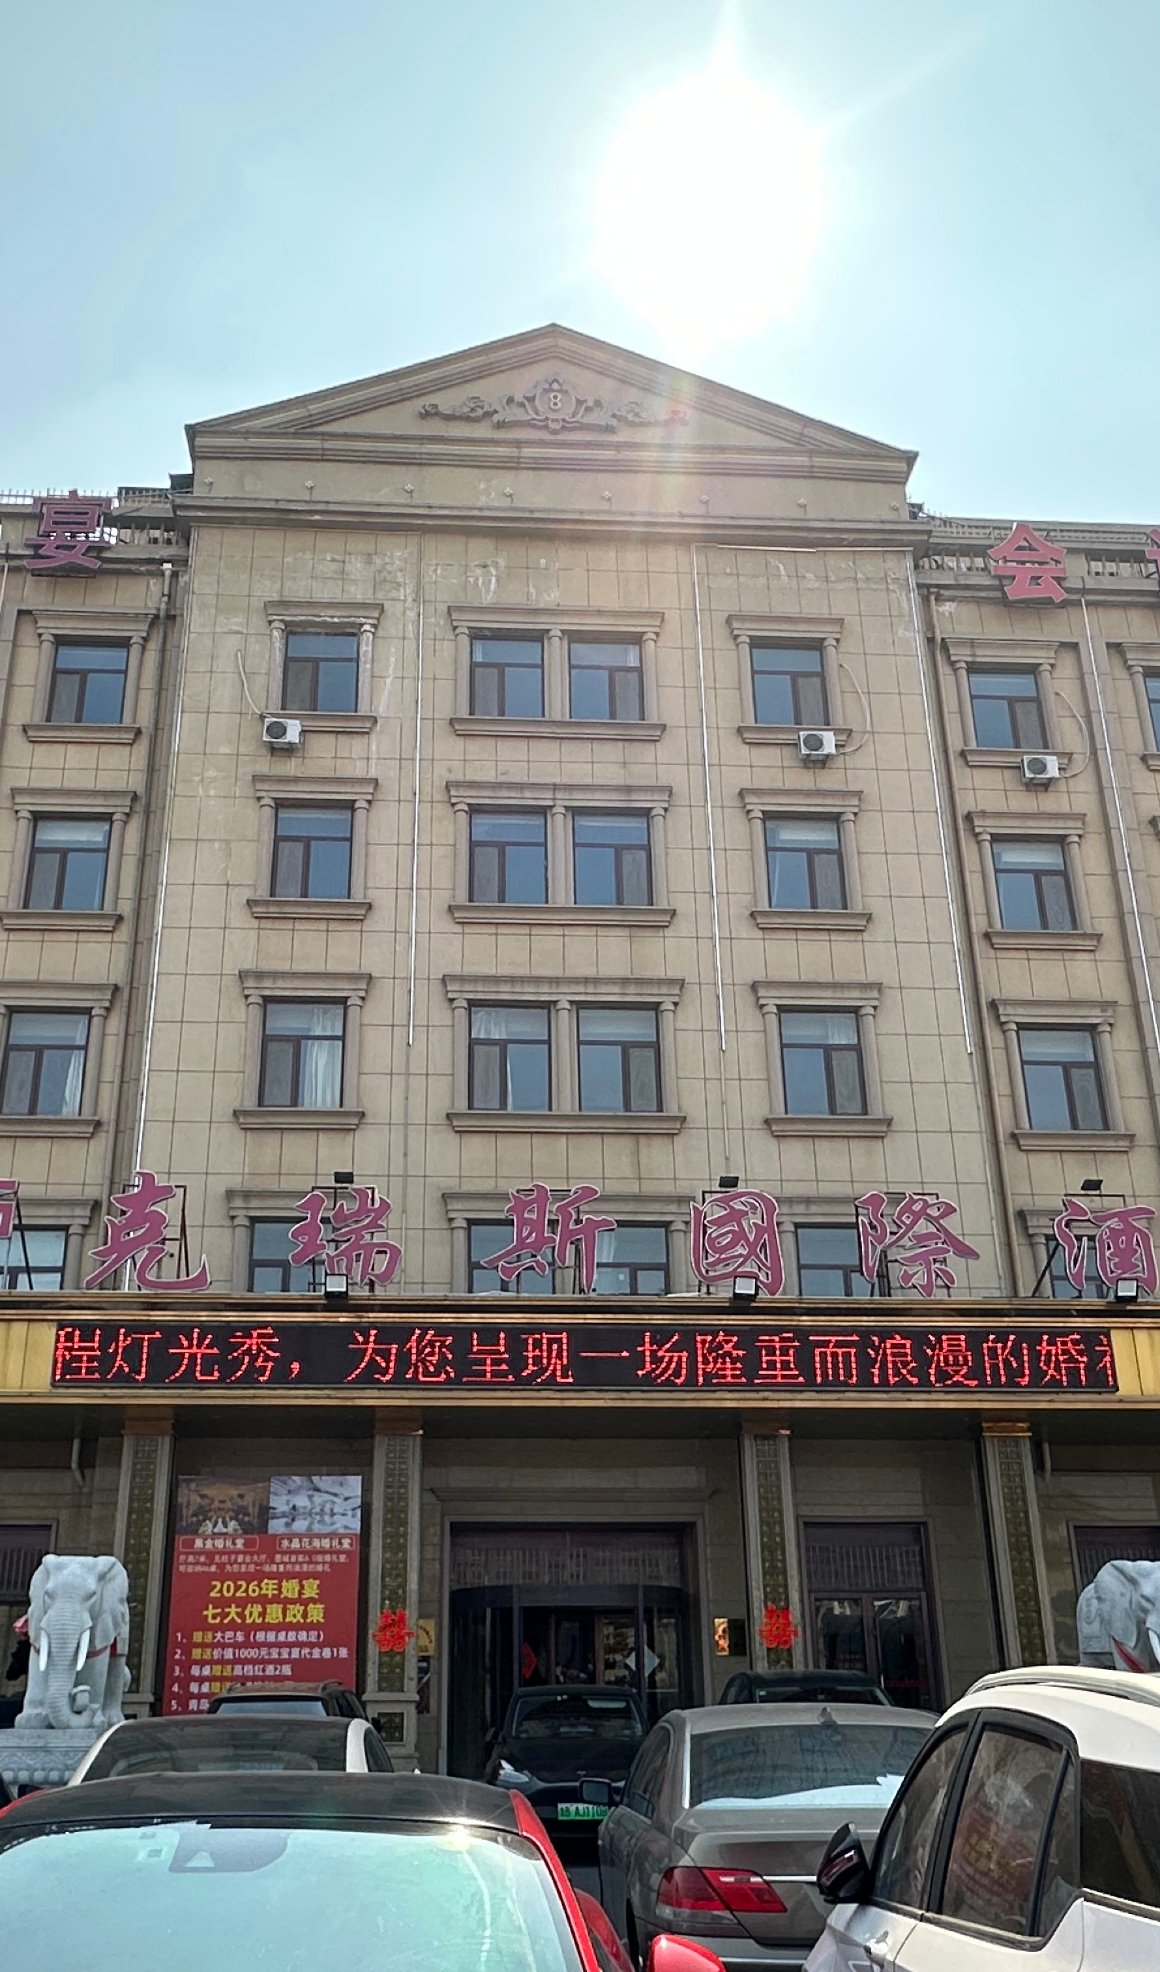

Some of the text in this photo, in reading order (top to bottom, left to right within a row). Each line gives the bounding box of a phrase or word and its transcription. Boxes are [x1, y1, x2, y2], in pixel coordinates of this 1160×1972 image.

[24, 489, 112, 569] 宴
[0, 1170, 1158, 1298] 克瑞斯國際酒
[202, 1603, 326, 1624] 七大优惠政策
[209, 1578, 321, 1599] 2026年婚宴
